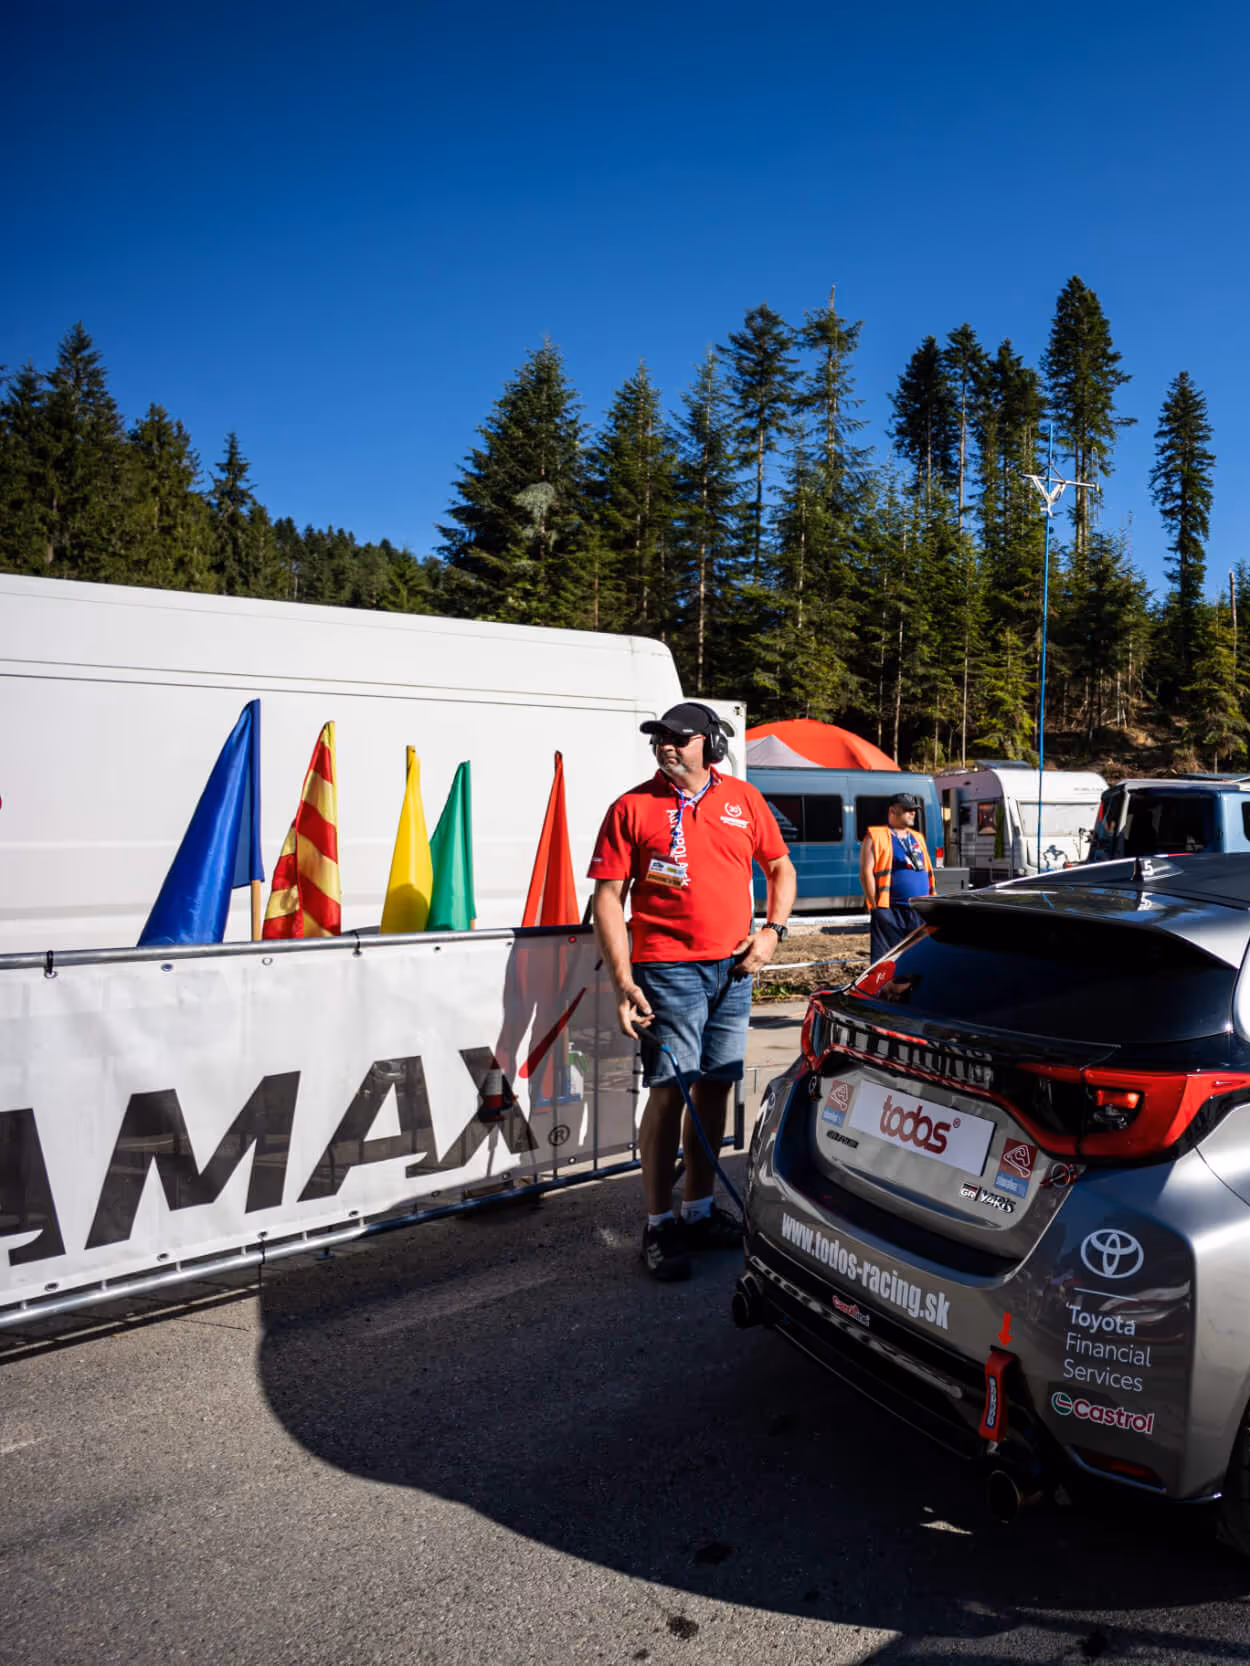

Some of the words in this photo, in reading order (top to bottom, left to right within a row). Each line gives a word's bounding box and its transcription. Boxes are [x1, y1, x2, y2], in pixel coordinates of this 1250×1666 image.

[880, 1096, 952, 1154] todos
[960, 1188, 976, 1200] GR
[980, 1190, 1016, 1213] YARIS
[781, 1213, 950, 1330] www.todos-racing.sk
[1070, 1305, 1136, 1336] Toyota
[1066, 1332, 1152, 1368] Financial
[1063, 1358, 1143, 1392] Services
[1072, 1398, 1155, 1434] Castrol
